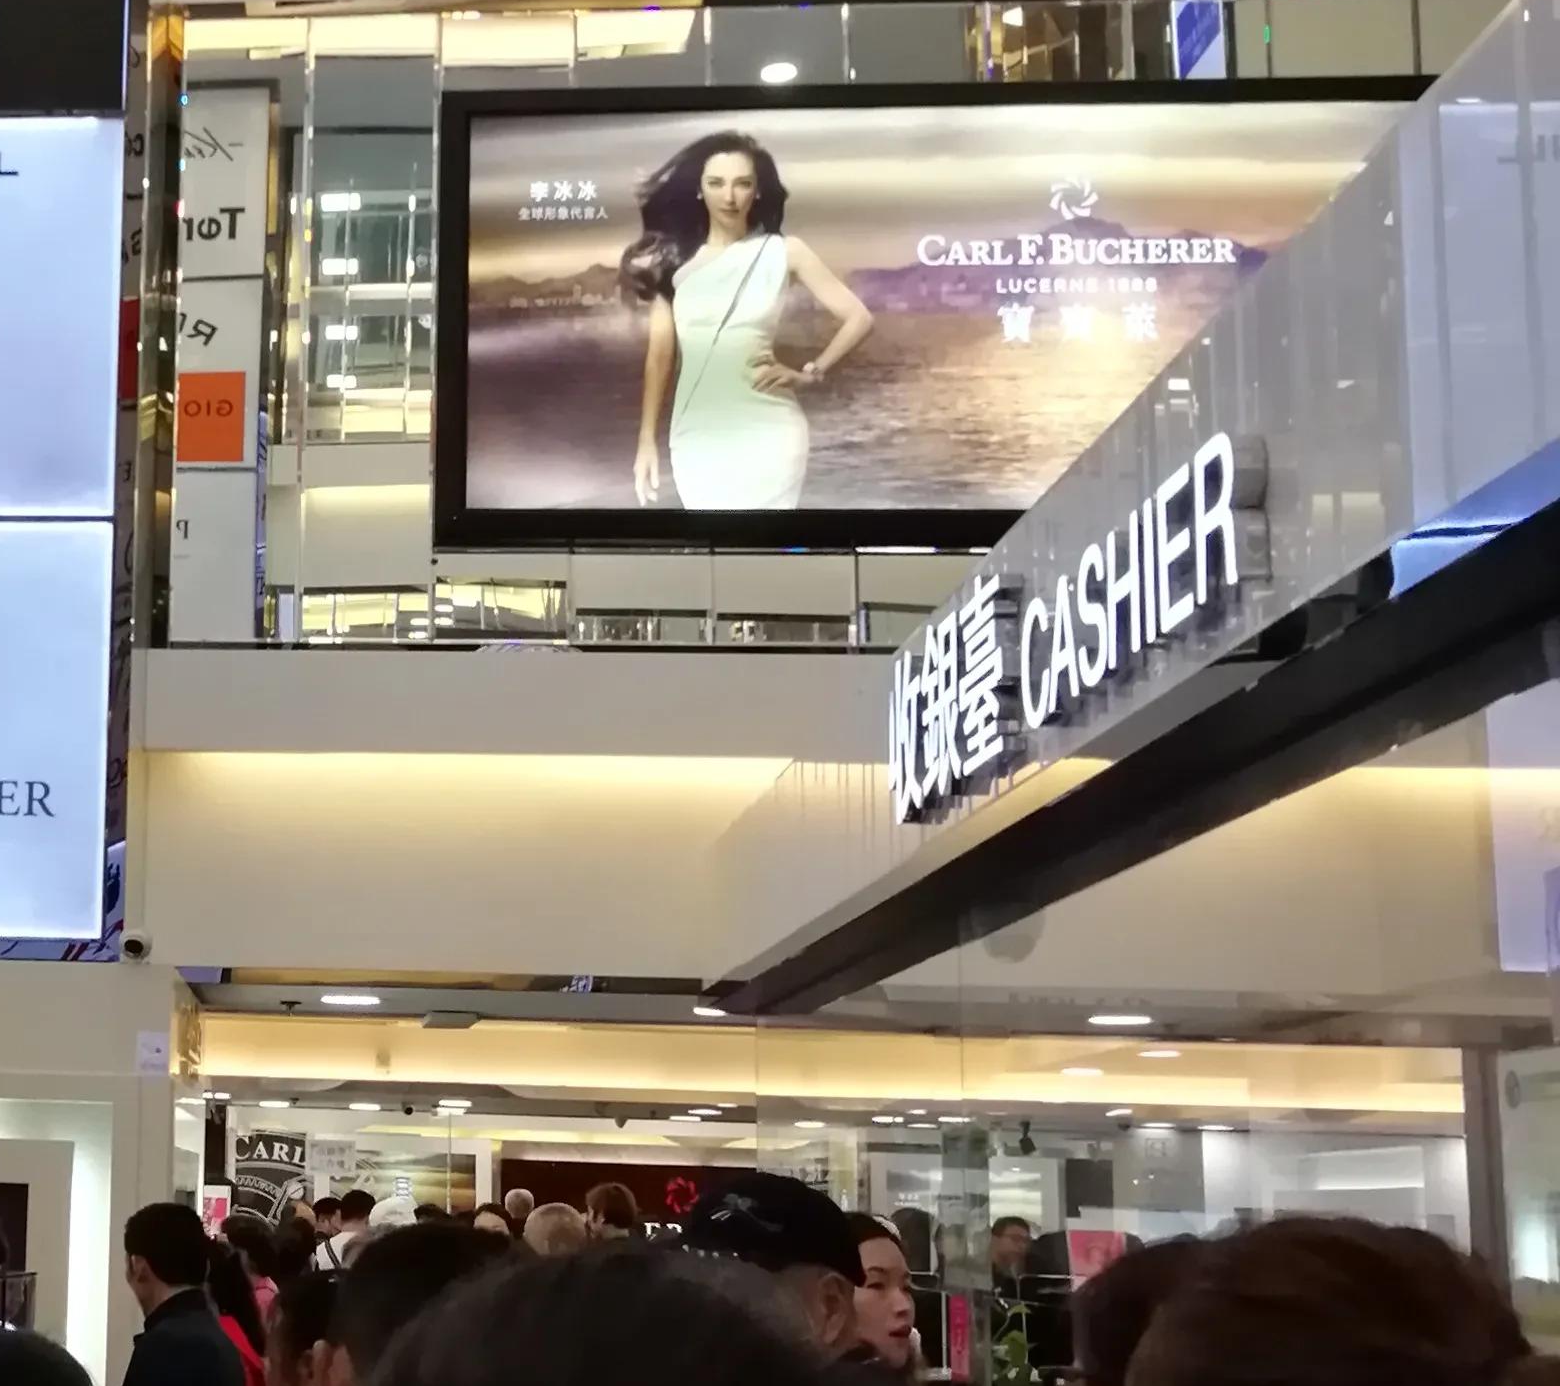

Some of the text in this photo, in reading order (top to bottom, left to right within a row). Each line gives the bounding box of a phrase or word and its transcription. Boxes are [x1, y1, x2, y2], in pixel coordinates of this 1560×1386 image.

[530, 180, 597, 202] 李冰冰
[917, 234, 1237, 266] CARL F. BUCHERER
[996, 277, 1098, 294] LUCERNE
[1020, 432, 1238, 729] CASHIER
